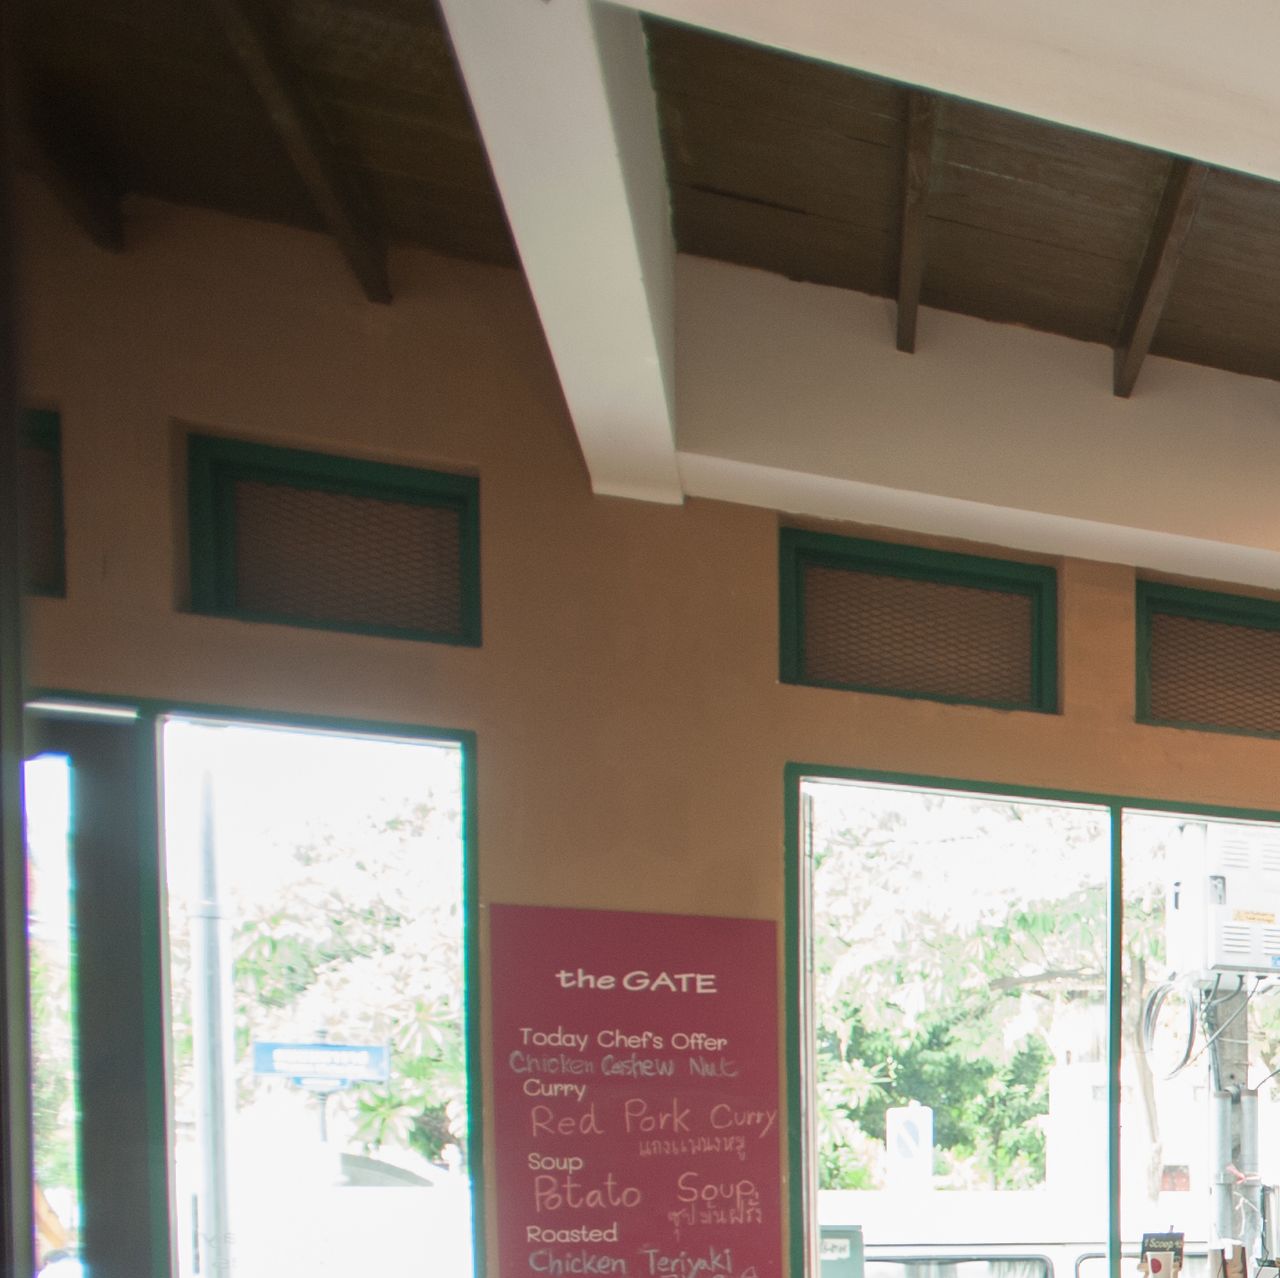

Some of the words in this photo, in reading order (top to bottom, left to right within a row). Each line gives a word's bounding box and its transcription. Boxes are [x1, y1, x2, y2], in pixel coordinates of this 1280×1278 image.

[555, 968, 615, 990] the
[622, 970, 717, 994] GATE
[520, 1026, 588, 1052] Today
[597, 1029, 663, 1050] Chef's
[671, 1033, 728, 1051] Offer
[523, 1078, 586, 1101] Curry
[531, 1102, 605, 1137] Red
[624, 1097, 692, 1134] Pork
[710, 1103, 777, 1138] Curry
[528, 1153, 583, 1174] Soup
[534, 1172, 641, 1213] Potato
[677, 1171, 756, 1211] Soup
[526, 1222, 619, 1243] Roasted
[528, 1249, 627, 1276] Chicken
